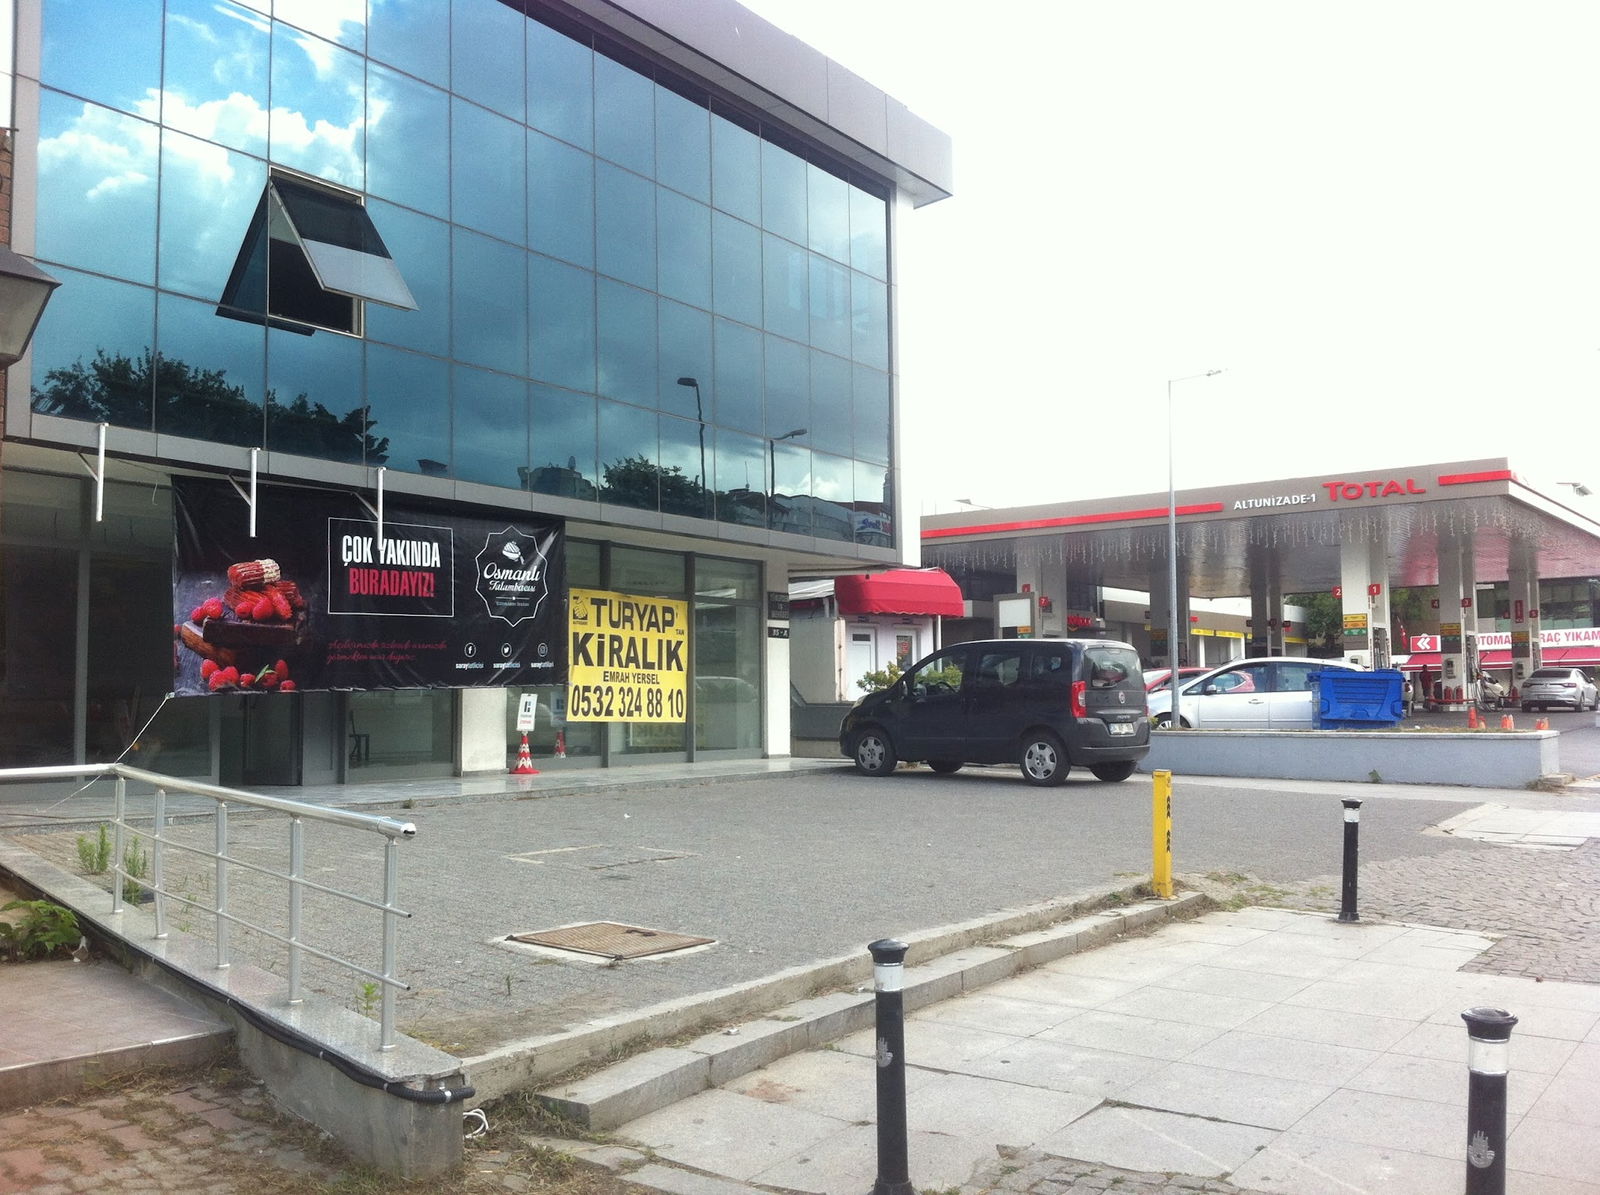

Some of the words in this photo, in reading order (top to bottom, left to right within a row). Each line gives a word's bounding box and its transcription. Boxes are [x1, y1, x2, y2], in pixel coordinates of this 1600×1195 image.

[1234, 492, 1316, 510] ALTUNİZADE-1
[1322, 478, 1426, 502] TOTAL
[342, 535, 373, 566] ÇOK
[379, 538, 441, 568] YAKINDA
[349, 567, 435, 598] BURADAYIZ!
[483, 562, 540, 582] Osmanlı
[590, 597, 675, 633] TURYAP
[603, 671, 630, 684] EMRAH
[632, 672, 660, 685] YERSEL
[571, 685, 614, 717] 0532
[618, 685, 642, 718] 324
[646, 688, 663, 718] 88
[667, 688, 684, 718] 10
